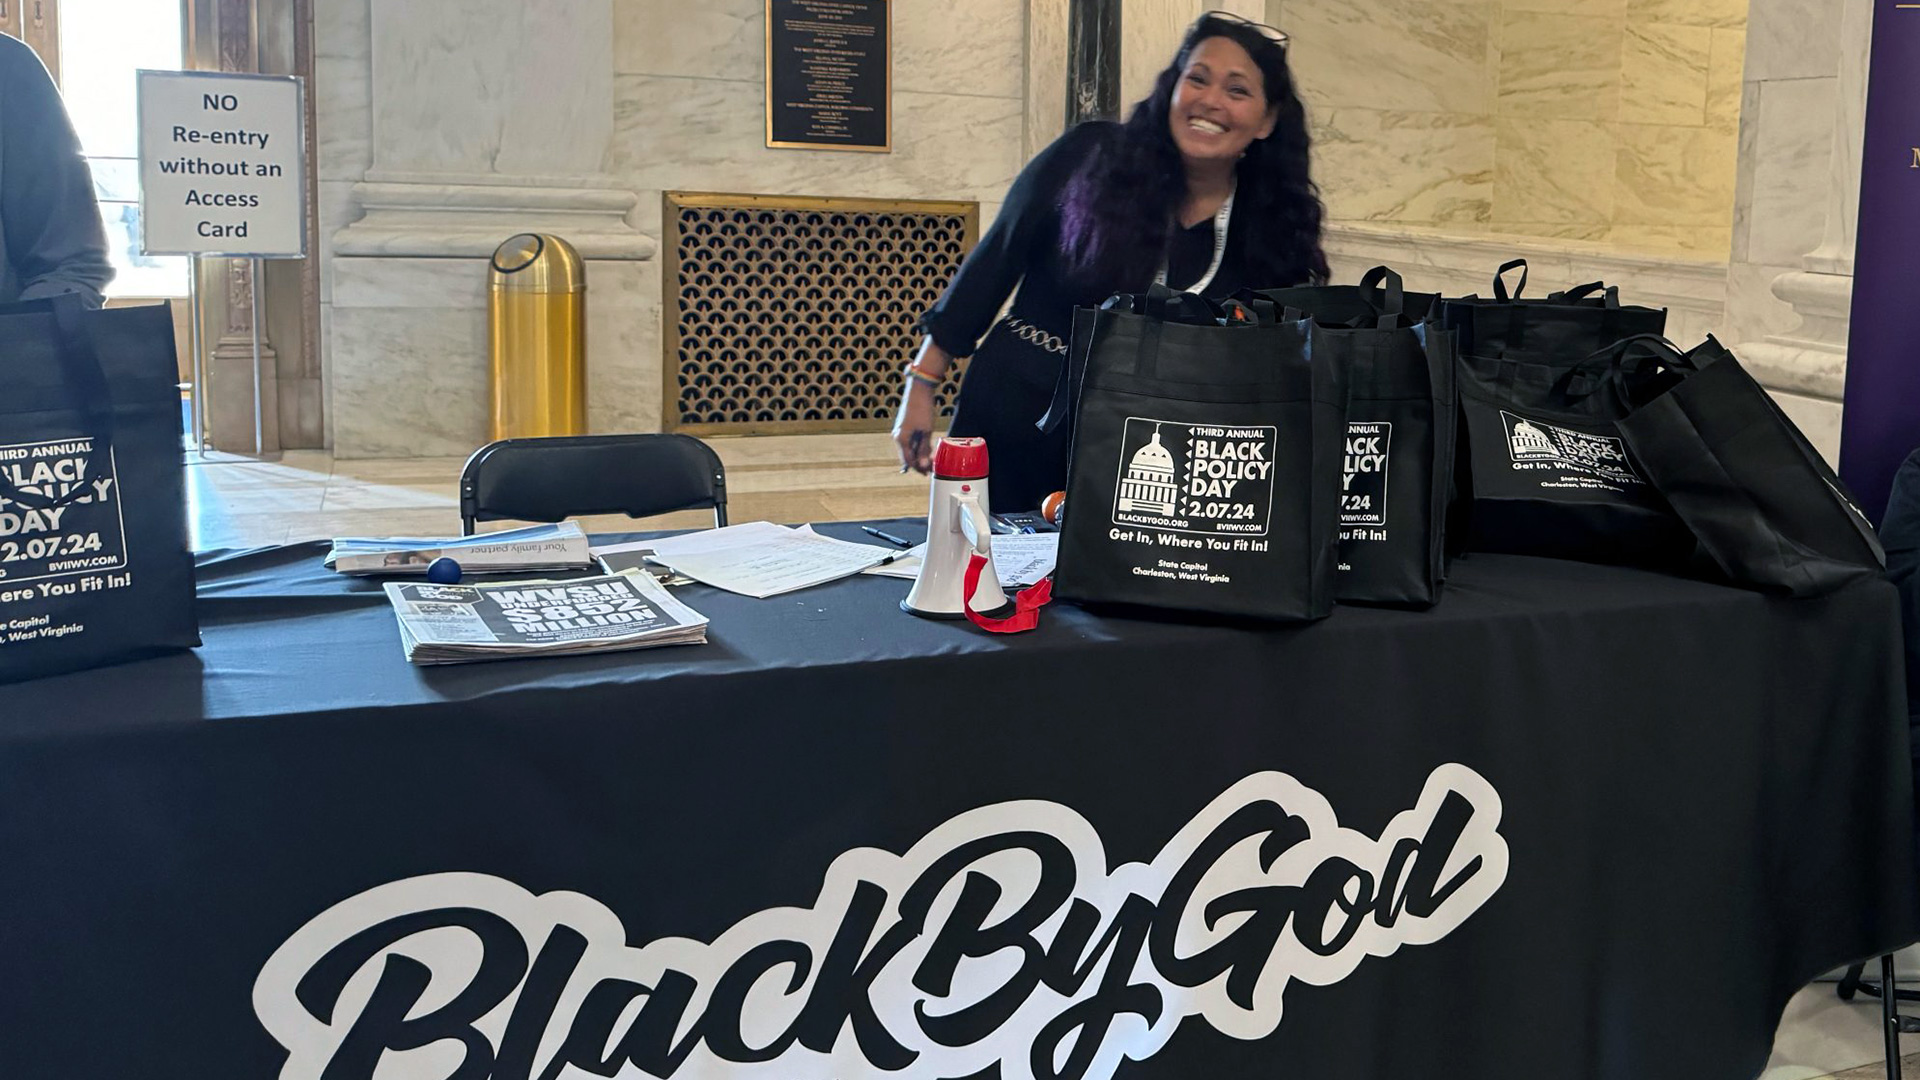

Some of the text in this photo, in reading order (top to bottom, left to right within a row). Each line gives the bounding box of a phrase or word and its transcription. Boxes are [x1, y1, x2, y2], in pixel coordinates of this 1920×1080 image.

[203, 94, 238, 111] NO
[173, 126, 269, 149] Re-entry
[159, 157, 282, 177] without an
[185, 189, 259, 207] Access
[197, 221, 248, 237] Card
[1196, 427, 1265, 438] THIRD ANNUAL
[31, 442, 93, 459] ANNUAL
[1195, 440, 1265, 460] BLACK
[1558, 433, 1616, 454] BLACK
[1193, 460, 1272, 480] POLICY
[1344, 454, 1386, 473] LICY
[1512, 462, 1534, 470] Get
[1553, 461, 1592, 473] Where
[1190, 478, 1238, 498] DAY
[1188, 501, 1255, 520] 2.07.24
[0, 507, 66, 536] DAY
[1118, 513, 1189, 528] BLACKBYGOD.ORG
[1109, 527, 1269, 552] Get In, Where You Fit In!
[1352, 528, 1367, 540] Fit
[1370, 529, 1387, 541] In!
[2, 532, 103, 563] 2.07.24
[471, 543, 567, 554] Your family partner
[1158, 559, 1208, 571] State Capitol
[1132, 567, 1230, 584] Charleston, West Virginia
[0, 572, 132, 602] ere You Fit In!
[487, 581, 630, 605] WVSU
[502, 598, 648, 624] $852
[9, 614, 50, 629] Capitol
[511, 608, 658, 634] MILLION
[8, 631, 37, 642] West
[39, 623, 84, 637] Virginia
